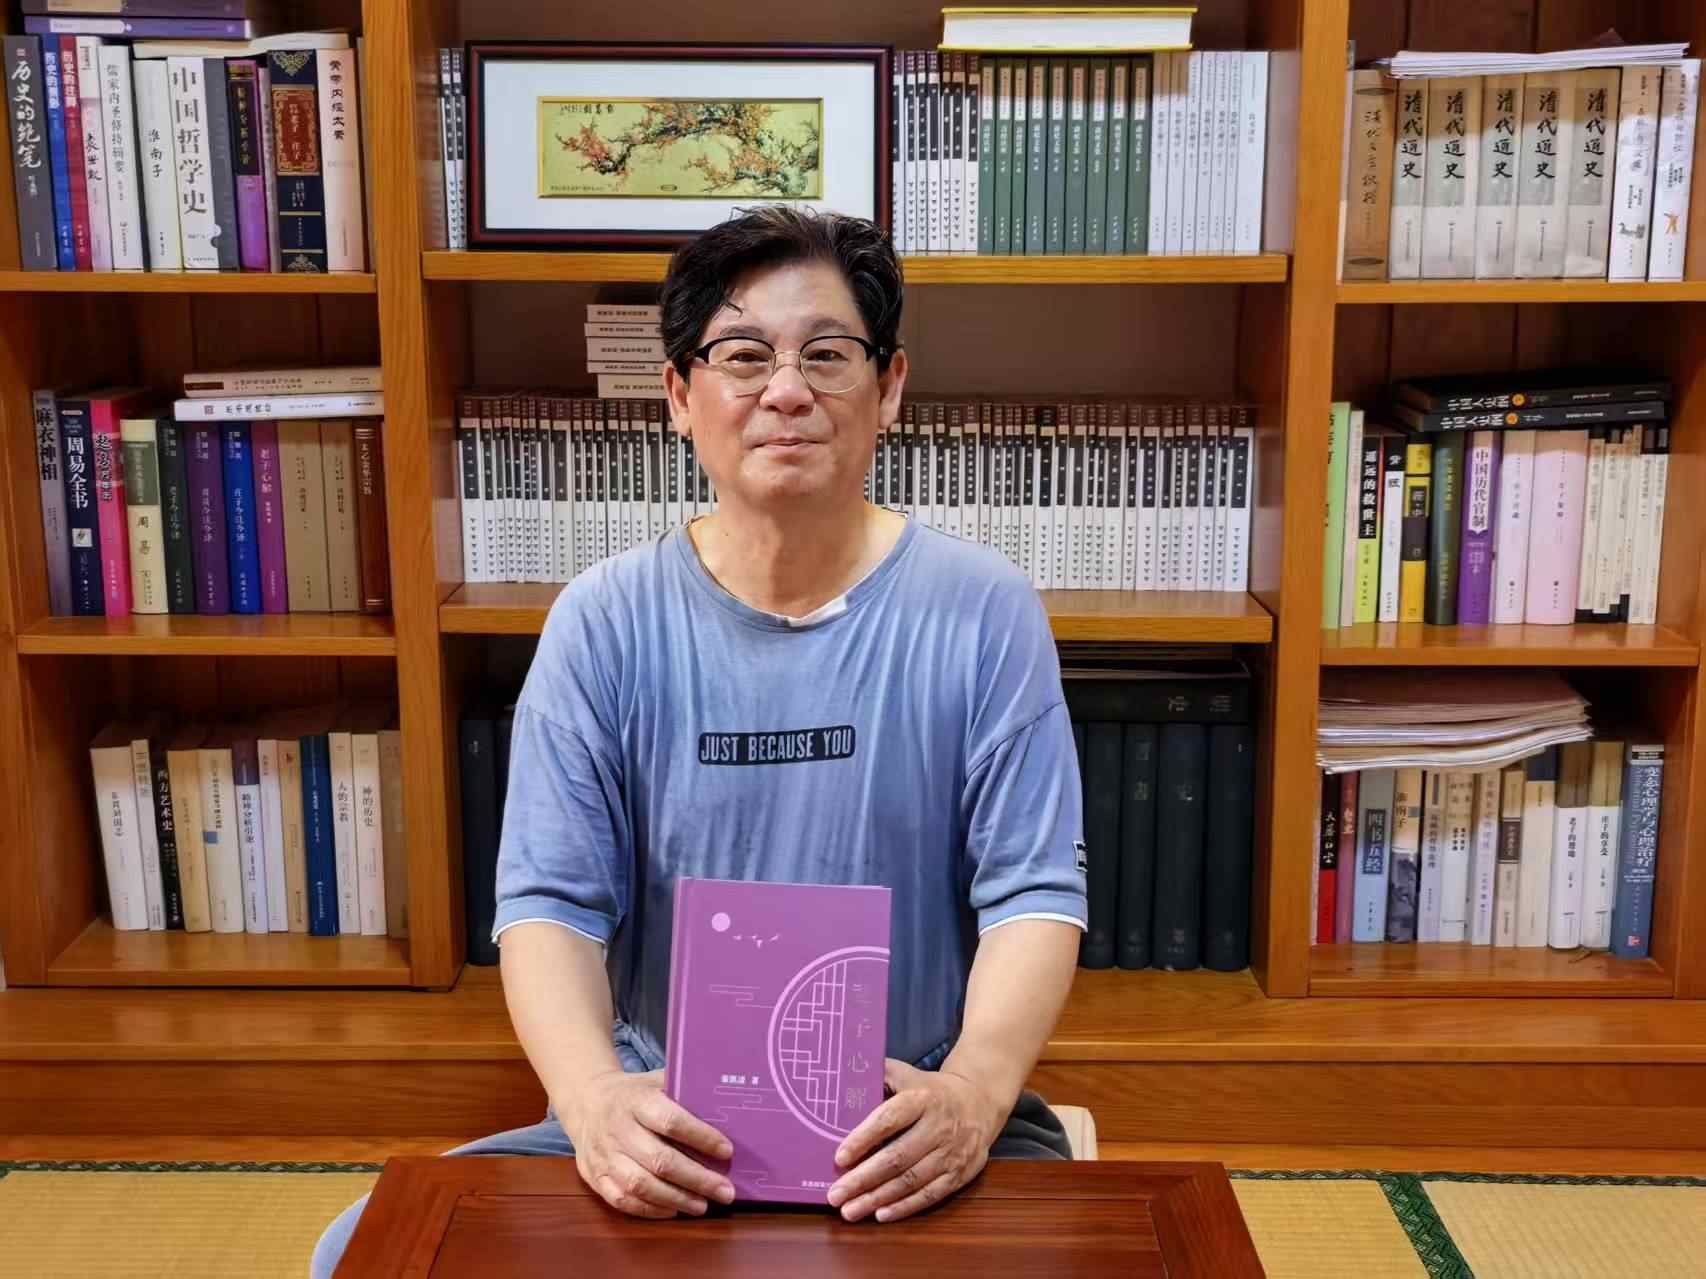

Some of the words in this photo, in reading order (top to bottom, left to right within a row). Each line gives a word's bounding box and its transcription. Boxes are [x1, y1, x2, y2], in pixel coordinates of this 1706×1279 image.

[149, 128, 164, 178] 淮南子
[173, 67, 207, 214] 中国哲学史
[1444, 90, 1465, 179] 清代通史
[1492, 90, 1514, 178] 清代通史
[1535, 90, 1560, 178] 清代通史
[1584, 89, 1607, 178] 清代通史
[1440, 413, 1504, 429] 中国人史纲
[1448, 395, 1509, 411] 中国人史纲
[36, 407, 57, 481] 麻衣神相
[67, 436, 89, 509] 周易全书
[1364, 451, 1377, 536] 遥远的救世主
[1472, 451, 1488, 527] 中国历代官制
[701, 735, 739, 761] JUST
[748, 732, 814, 761] BECAUSE
[823, 729, 851, 756] YOU
